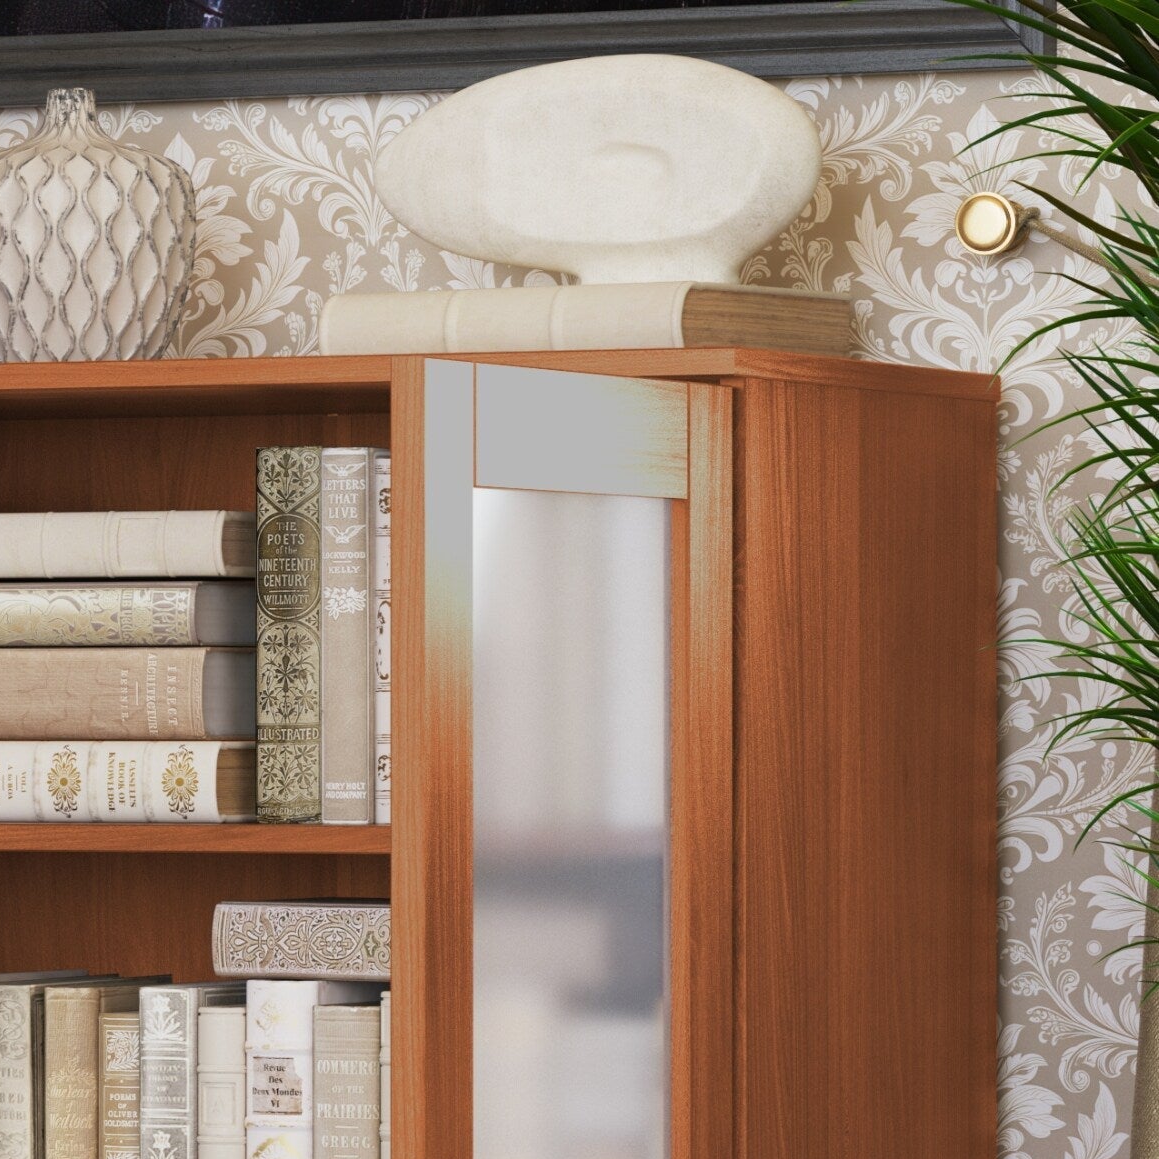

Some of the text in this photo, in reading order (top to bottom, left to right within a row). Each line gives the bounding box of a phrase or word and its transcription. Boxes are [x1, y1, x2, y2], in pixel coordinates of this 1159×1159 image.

[322, 478, 366, 491] LETTERS
[328, 493, 359, 504] THAT
[328, 507, 358, 519] LIVE
[276, 521, 297, 531] THE
[267, 533, 305, 546] POETS
[259, 558, 317, 572] NINETEENTH
[328, 566, 361, 574] KELLY
[263, 574, 310, 587] CENTURY
[263, 594, 310, 605] WILLMOTT
[166, 665, 178, 726] INSECT
[257, 727, 319, 741] ILLUSTRATED
[263, 1064, 287, 1072] Revue
[268, 1075, 283, 1084] Des
[109, 1093, 137, 1101] POEMS
[108, 1110, 138, 1118] OLIVER
[317, 1103, 380, 1120] PRAIRIES
[104, 1119, 140, 1128] GOLDSMIT
